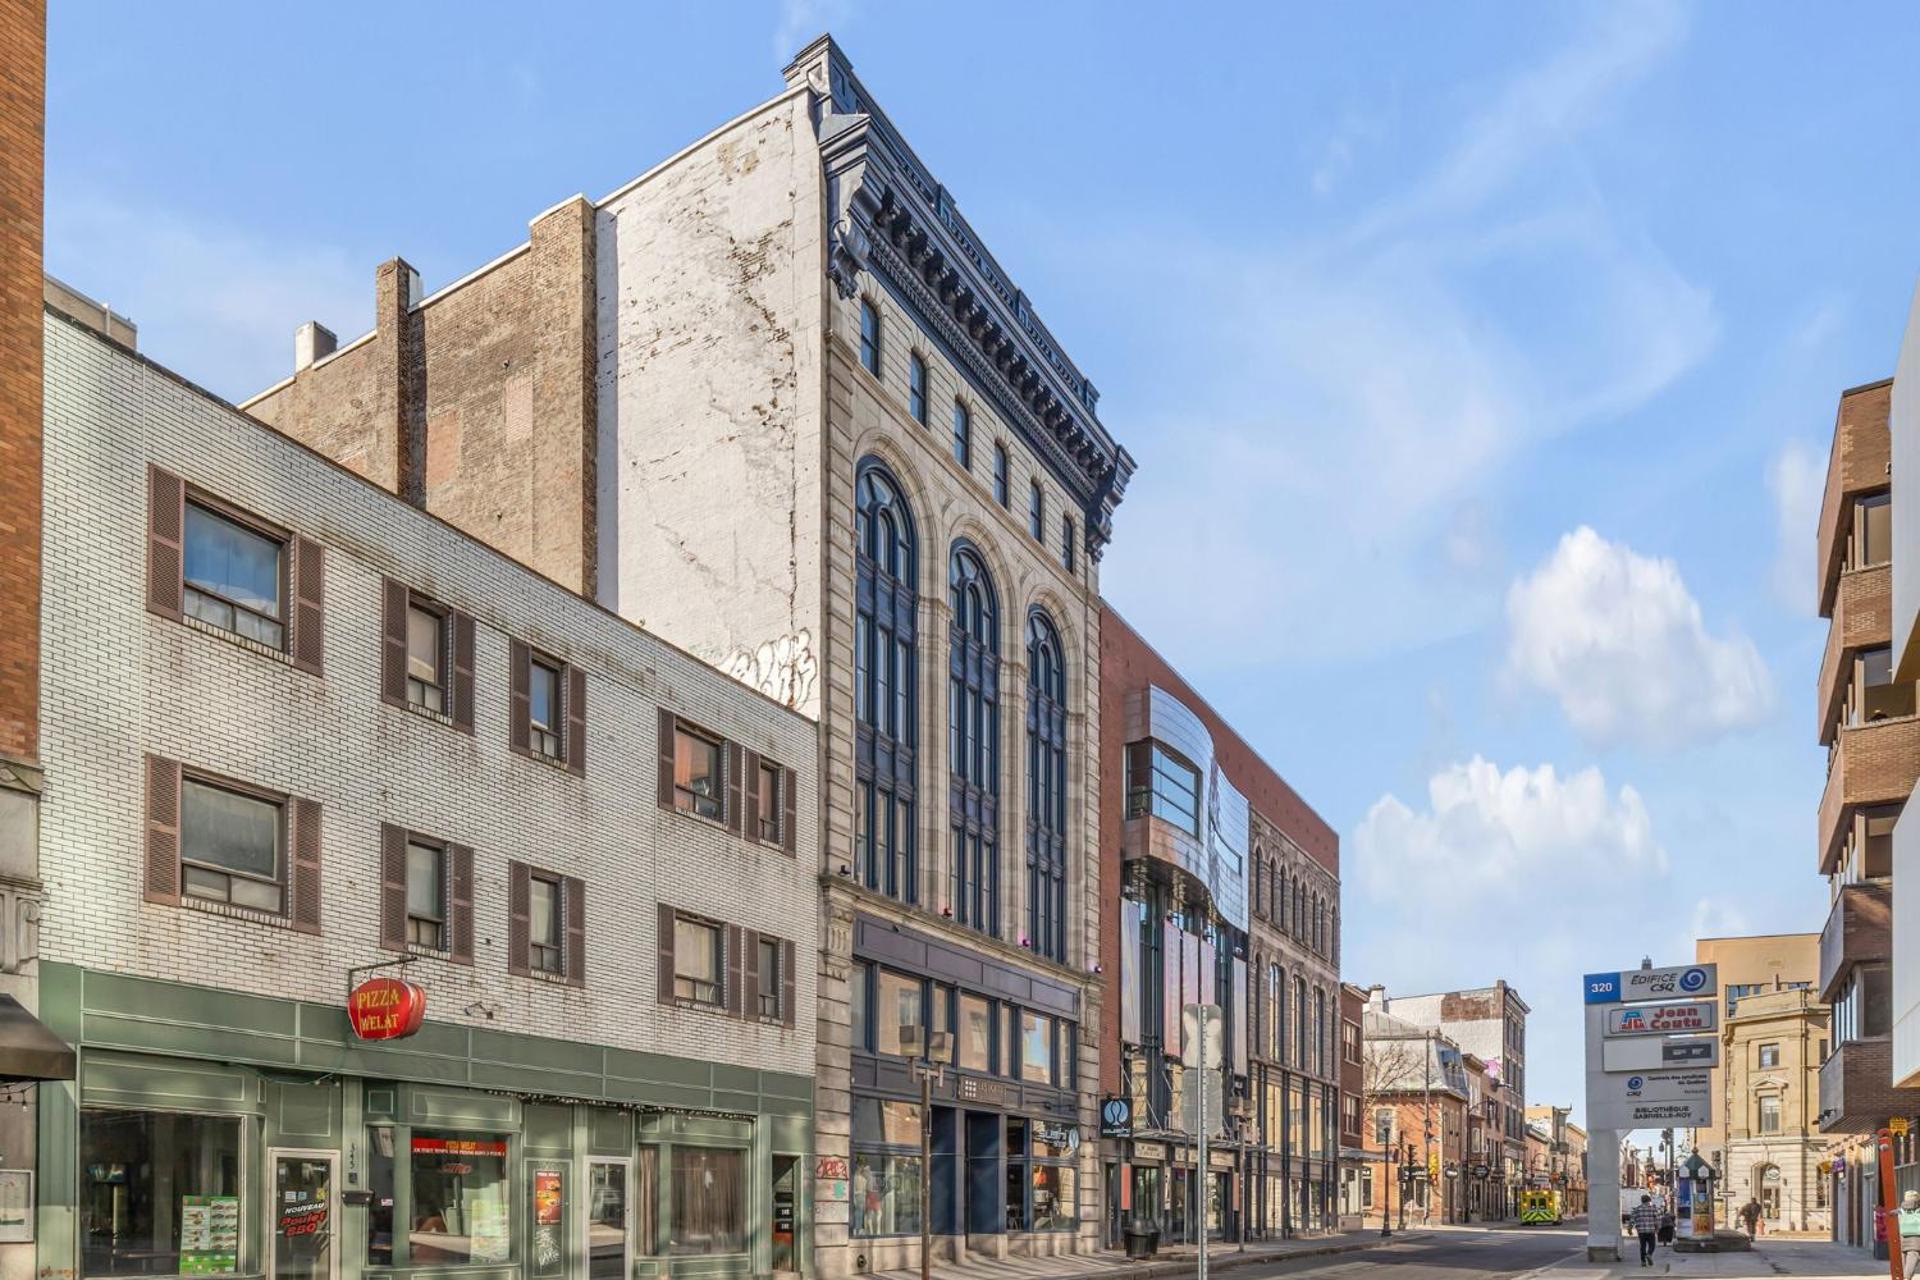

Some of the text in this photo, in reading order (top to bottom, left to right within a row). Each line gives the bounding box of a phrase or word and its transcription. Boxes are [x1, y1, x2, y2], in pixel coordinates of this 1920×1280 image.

[1591, 983, 1612, 992] 320
[1650, 982, 1676, 992] CSQ
[358, 989, 399, 1008] PIZZA
[1654, 1007, 1698, 1018] Jean
[361, 1014, 399, 1031] WELAT
[1650, 1017, 1703, 1030] Coutu
[285, 1203, 324, 1214] NOUVEAU
